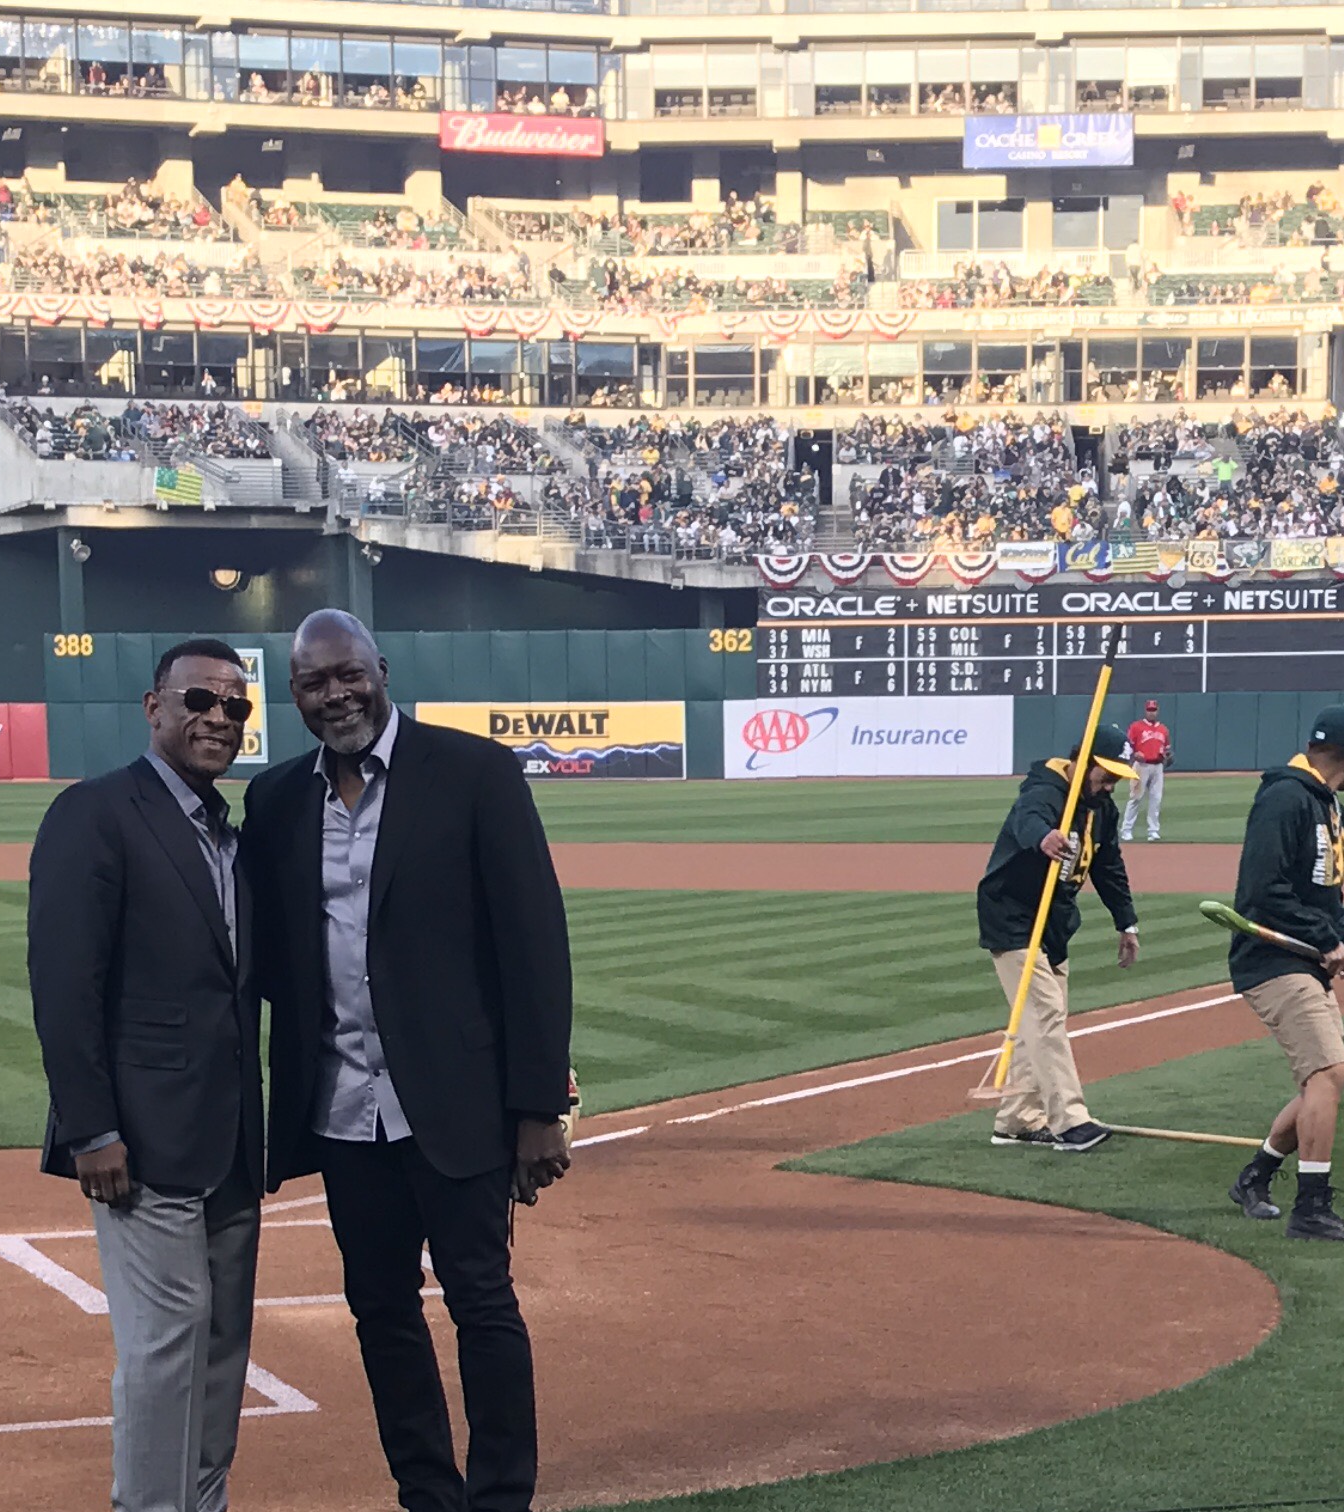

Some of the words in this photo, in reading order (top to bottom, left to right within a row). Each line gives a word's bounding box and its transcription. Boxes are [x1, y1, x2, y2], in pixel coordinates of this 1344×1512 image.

[448, 115, 596, 151] Budweiser
[975, 133, 1035, 148] CACHE
[1062, 132, 1119, 148] CREEK
[1008, 151, 1046, 160] CASINO
[1066, 541, 1099, 566] Cal
[1192, 552, 1214, 567] 66
[766, 596, 896, 616] ORACLE
[927, 593, 1039, 614] NETSUITE
[1062, 592, 1193, 612] ORACLE
[1224, 589, 1337, 611] NETSUITE
[801, 629, 831, 643] MIA
[887, 628, 895, 642] 2
[949, 627, 979, 641] COL
[1037, 626, 1044, 640] 7
[1186, 624, 1194, 637] 4
[53, 634, 94, 657] 388
[709, 628, 753, 653] 362
[1101, 641, 1127, 654] CN
[1186, 639, 1194, 653] 3
[802, 644, 831, 658] WSH
[887, 643, 895, 657] 4
[951, 643, 978, 656] MIL
[1037, 641, 1044, 655] 5
[803, 664, 829, 677] ATL
[950, 662, 978, 675] S.D.
[1036, 661, 1044, 675] 3
[800, 679, 832, 692] NYM
[887, 678, 895, 691] 6
[950, 677, 978, 691] L.A.
[749, 710, 806, 752] AAA
[850, 725, 968, 746] Insurance
[523, 760, 595, 774] EXVOLT
